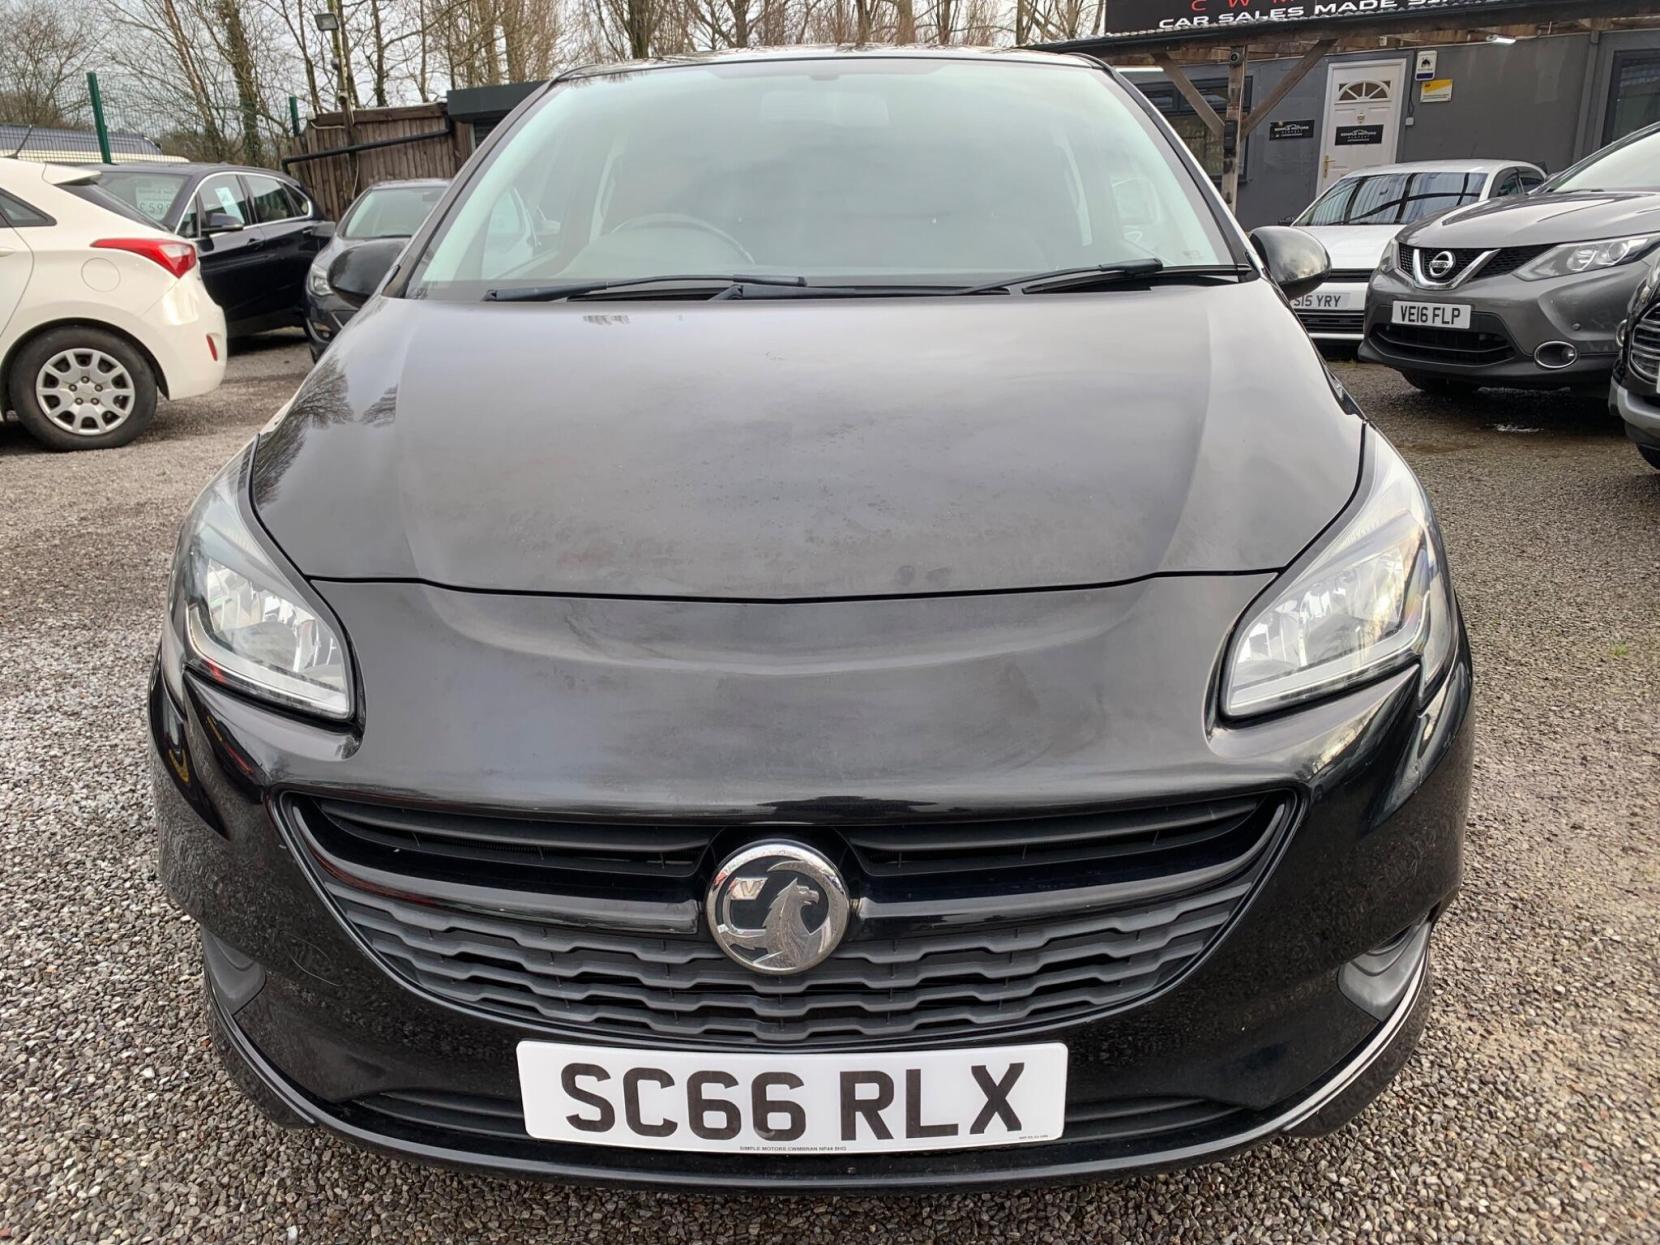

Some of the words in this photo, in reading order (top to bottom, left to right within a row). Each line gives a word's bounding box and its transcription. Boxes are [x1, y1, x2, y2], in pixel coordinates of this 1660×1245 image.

[1159, 15, 1210, 29] CAR
[1218, 6, 1305, 24] SALES
[1315, 0, 1398, 15] MADE
[1316, 295, 1342, 308] YRY
[1400, 305, 1429, 323] VE16
[1432, 307, 1461, 325] FLP
[560, 1062, 807, 1142] SC66
[840, 1062, 1026, 1141] RLX
